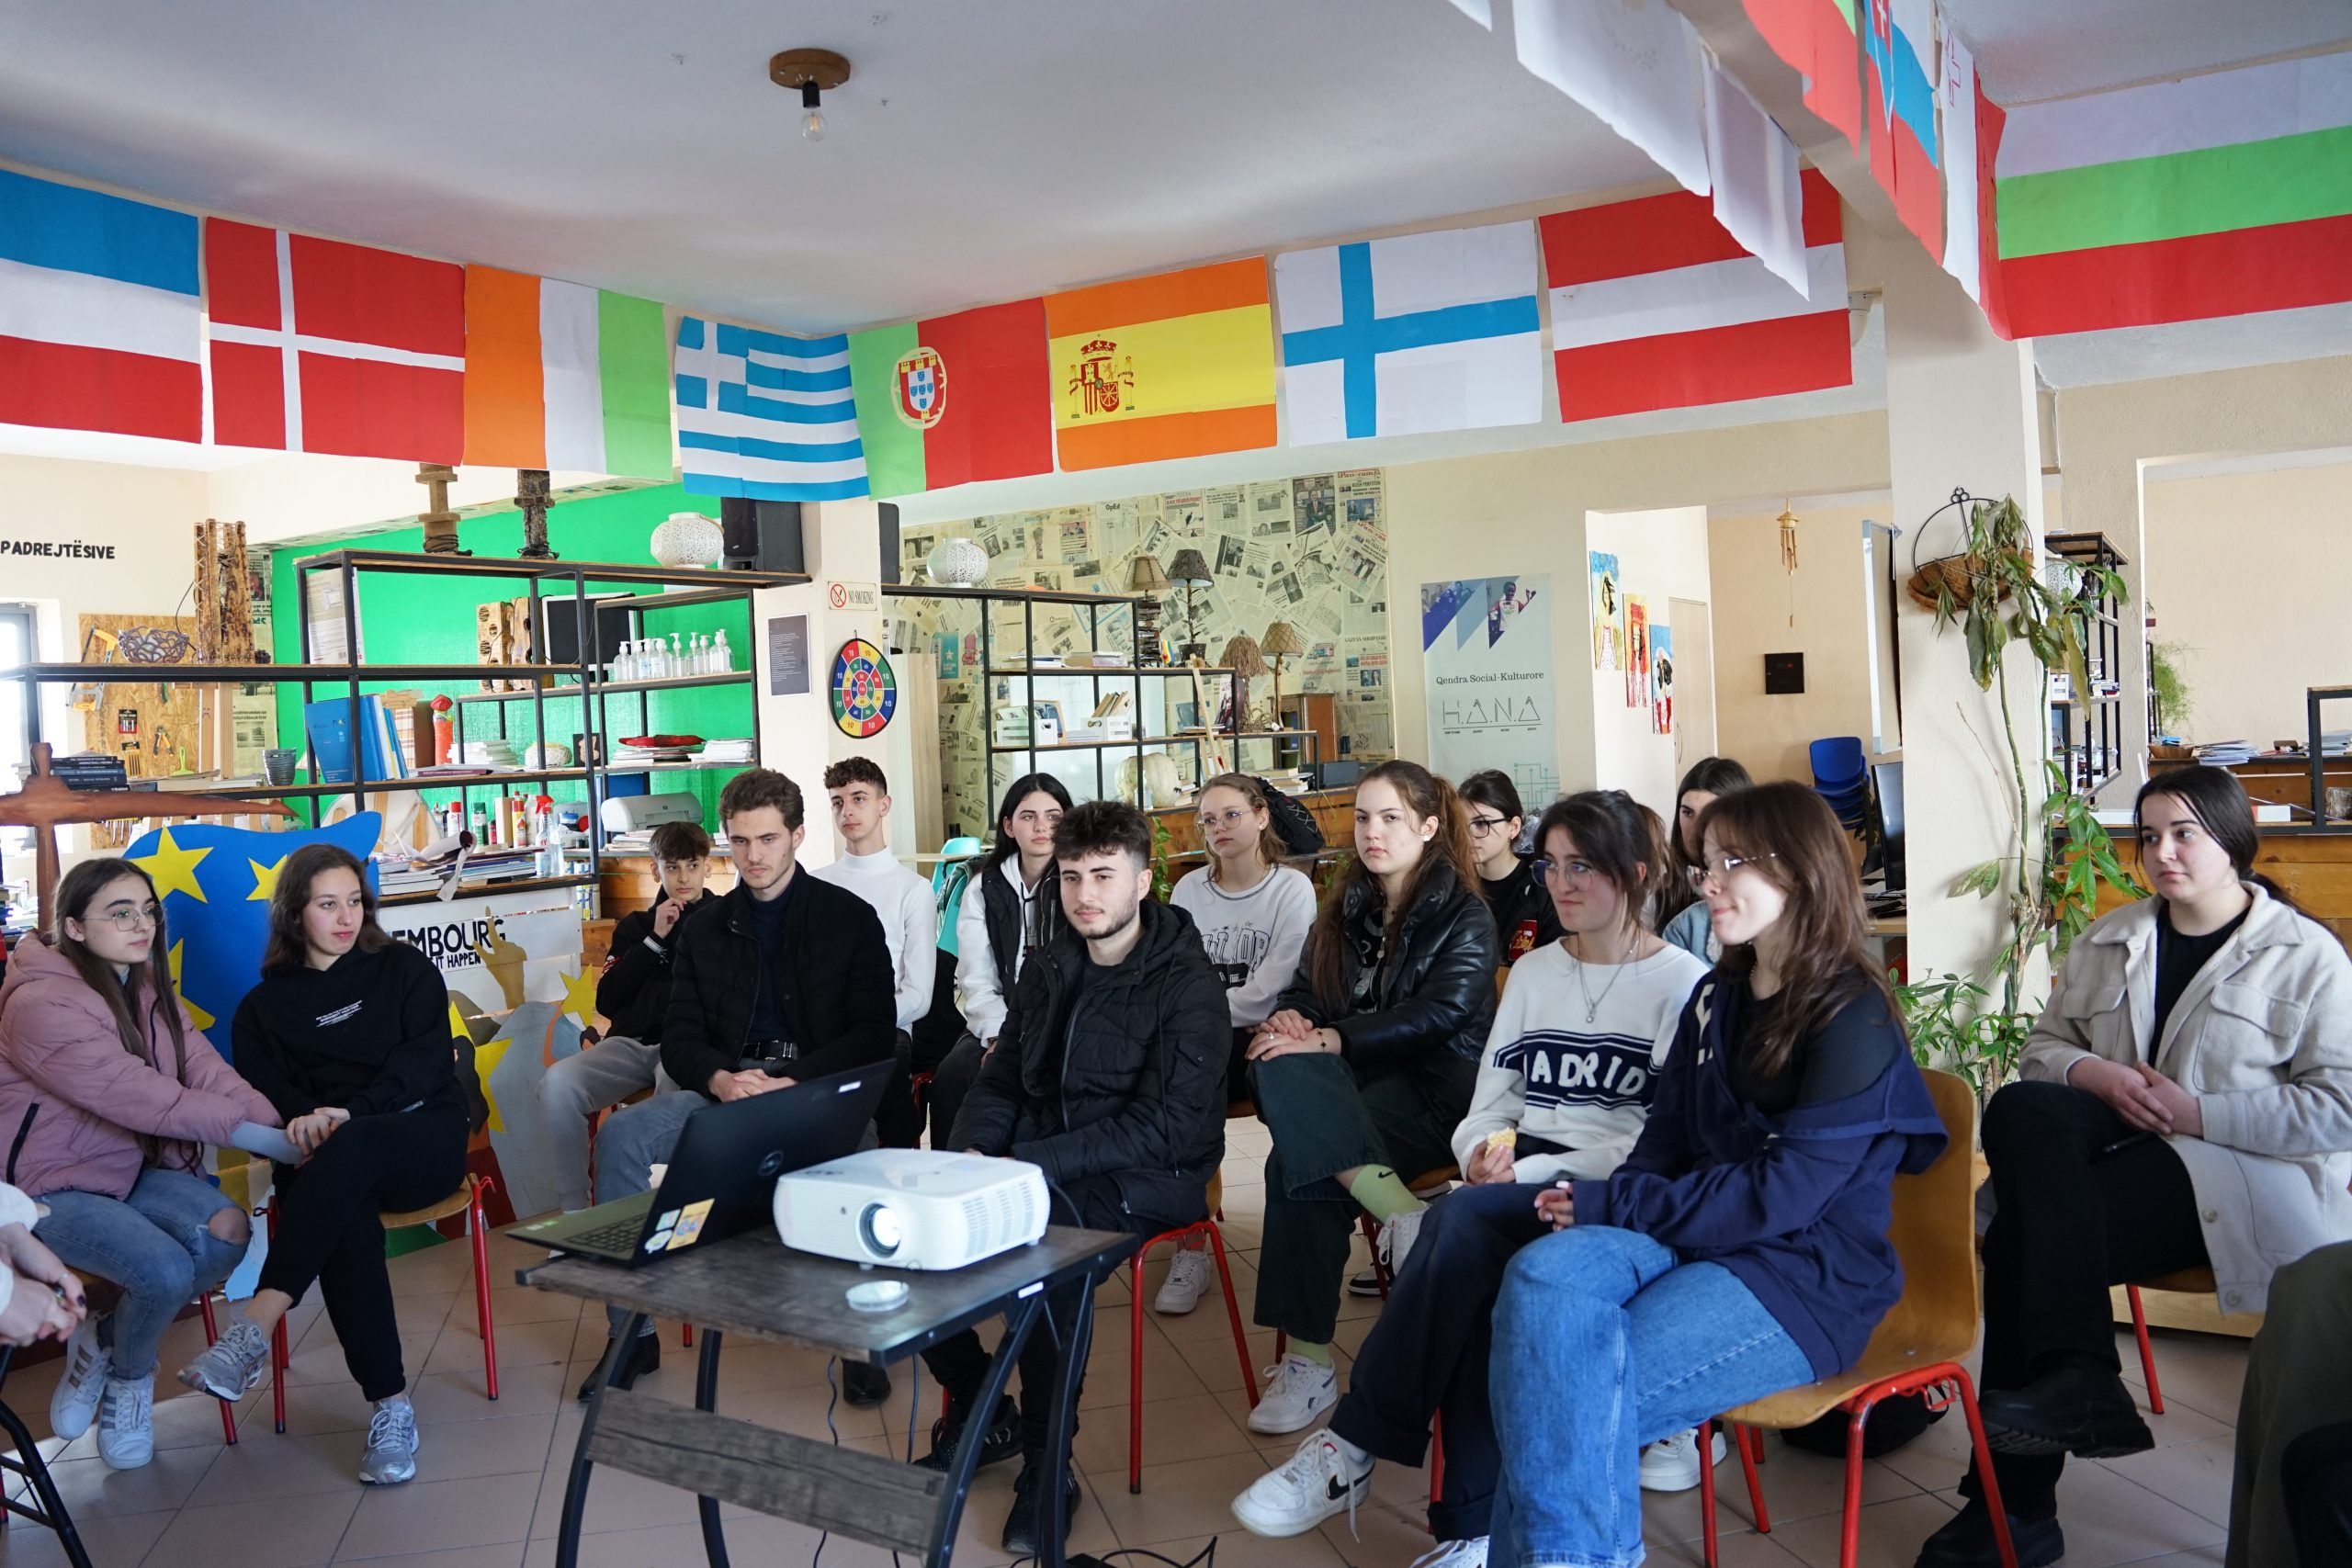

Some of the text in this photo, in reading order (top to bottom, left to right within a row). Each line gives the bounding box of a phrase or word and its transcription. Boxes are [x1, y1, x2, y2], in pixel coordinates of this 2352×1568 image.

[1105, 502, 1121, 512] OpEd
[0, 540, 116, 559] PADREJTËSIVE
[848, 591, 874, 604] NO SMOKING
[1436, 671, 1544, 685] Qendra Social-Kulturore
[447, 951, 481, 968] HAPPEN
[1523, 1049, 1646, 1096] ADRID
